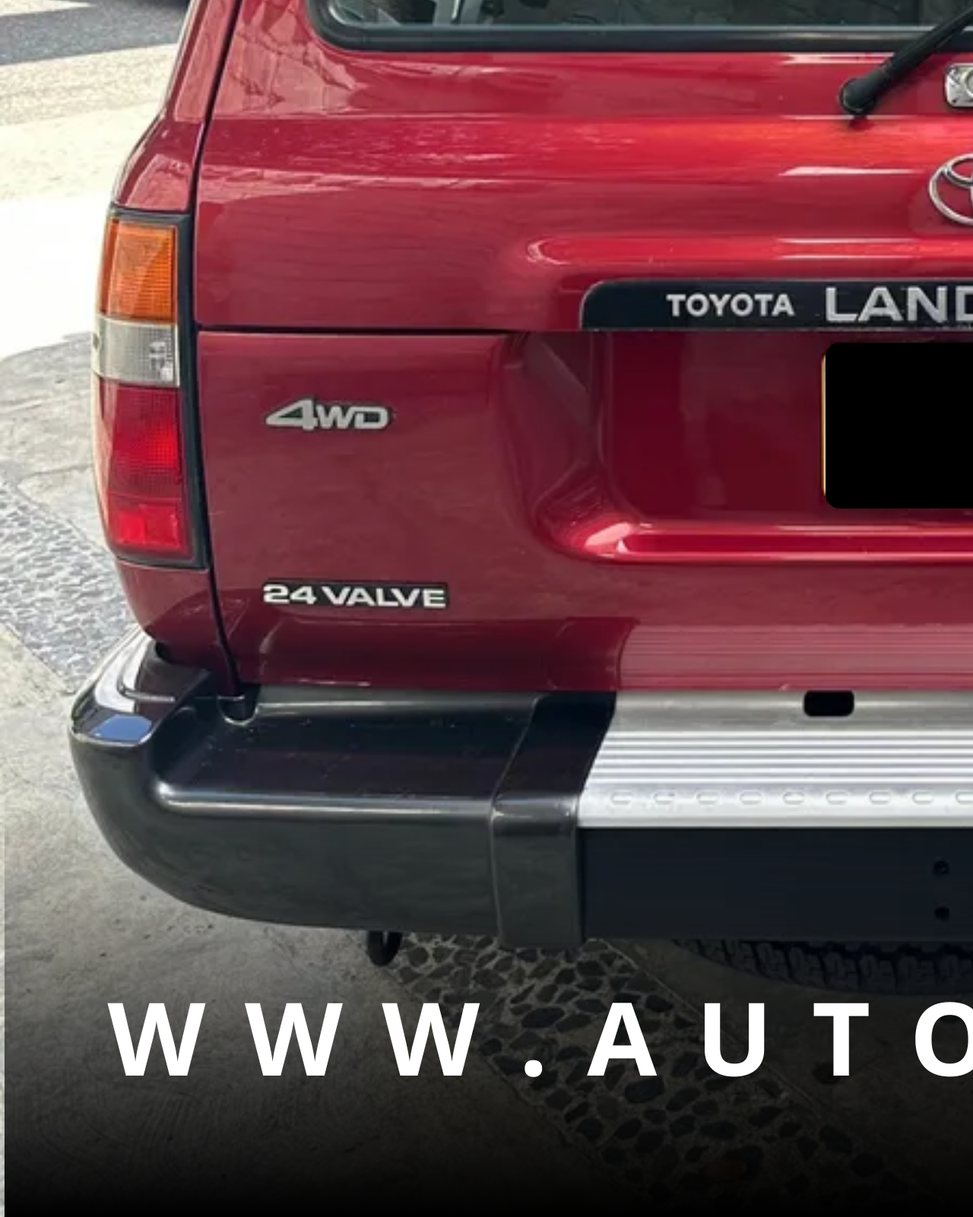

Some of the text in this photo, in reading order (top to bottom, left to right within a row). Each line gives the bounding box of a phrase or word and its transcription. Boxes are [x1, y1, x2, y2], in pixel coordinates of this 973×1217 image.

[666, 293, 795, 318] TOYOTA
[265, 397, 390, 431] 4WD
[262, 585, 447, 609] 24 VALVE
